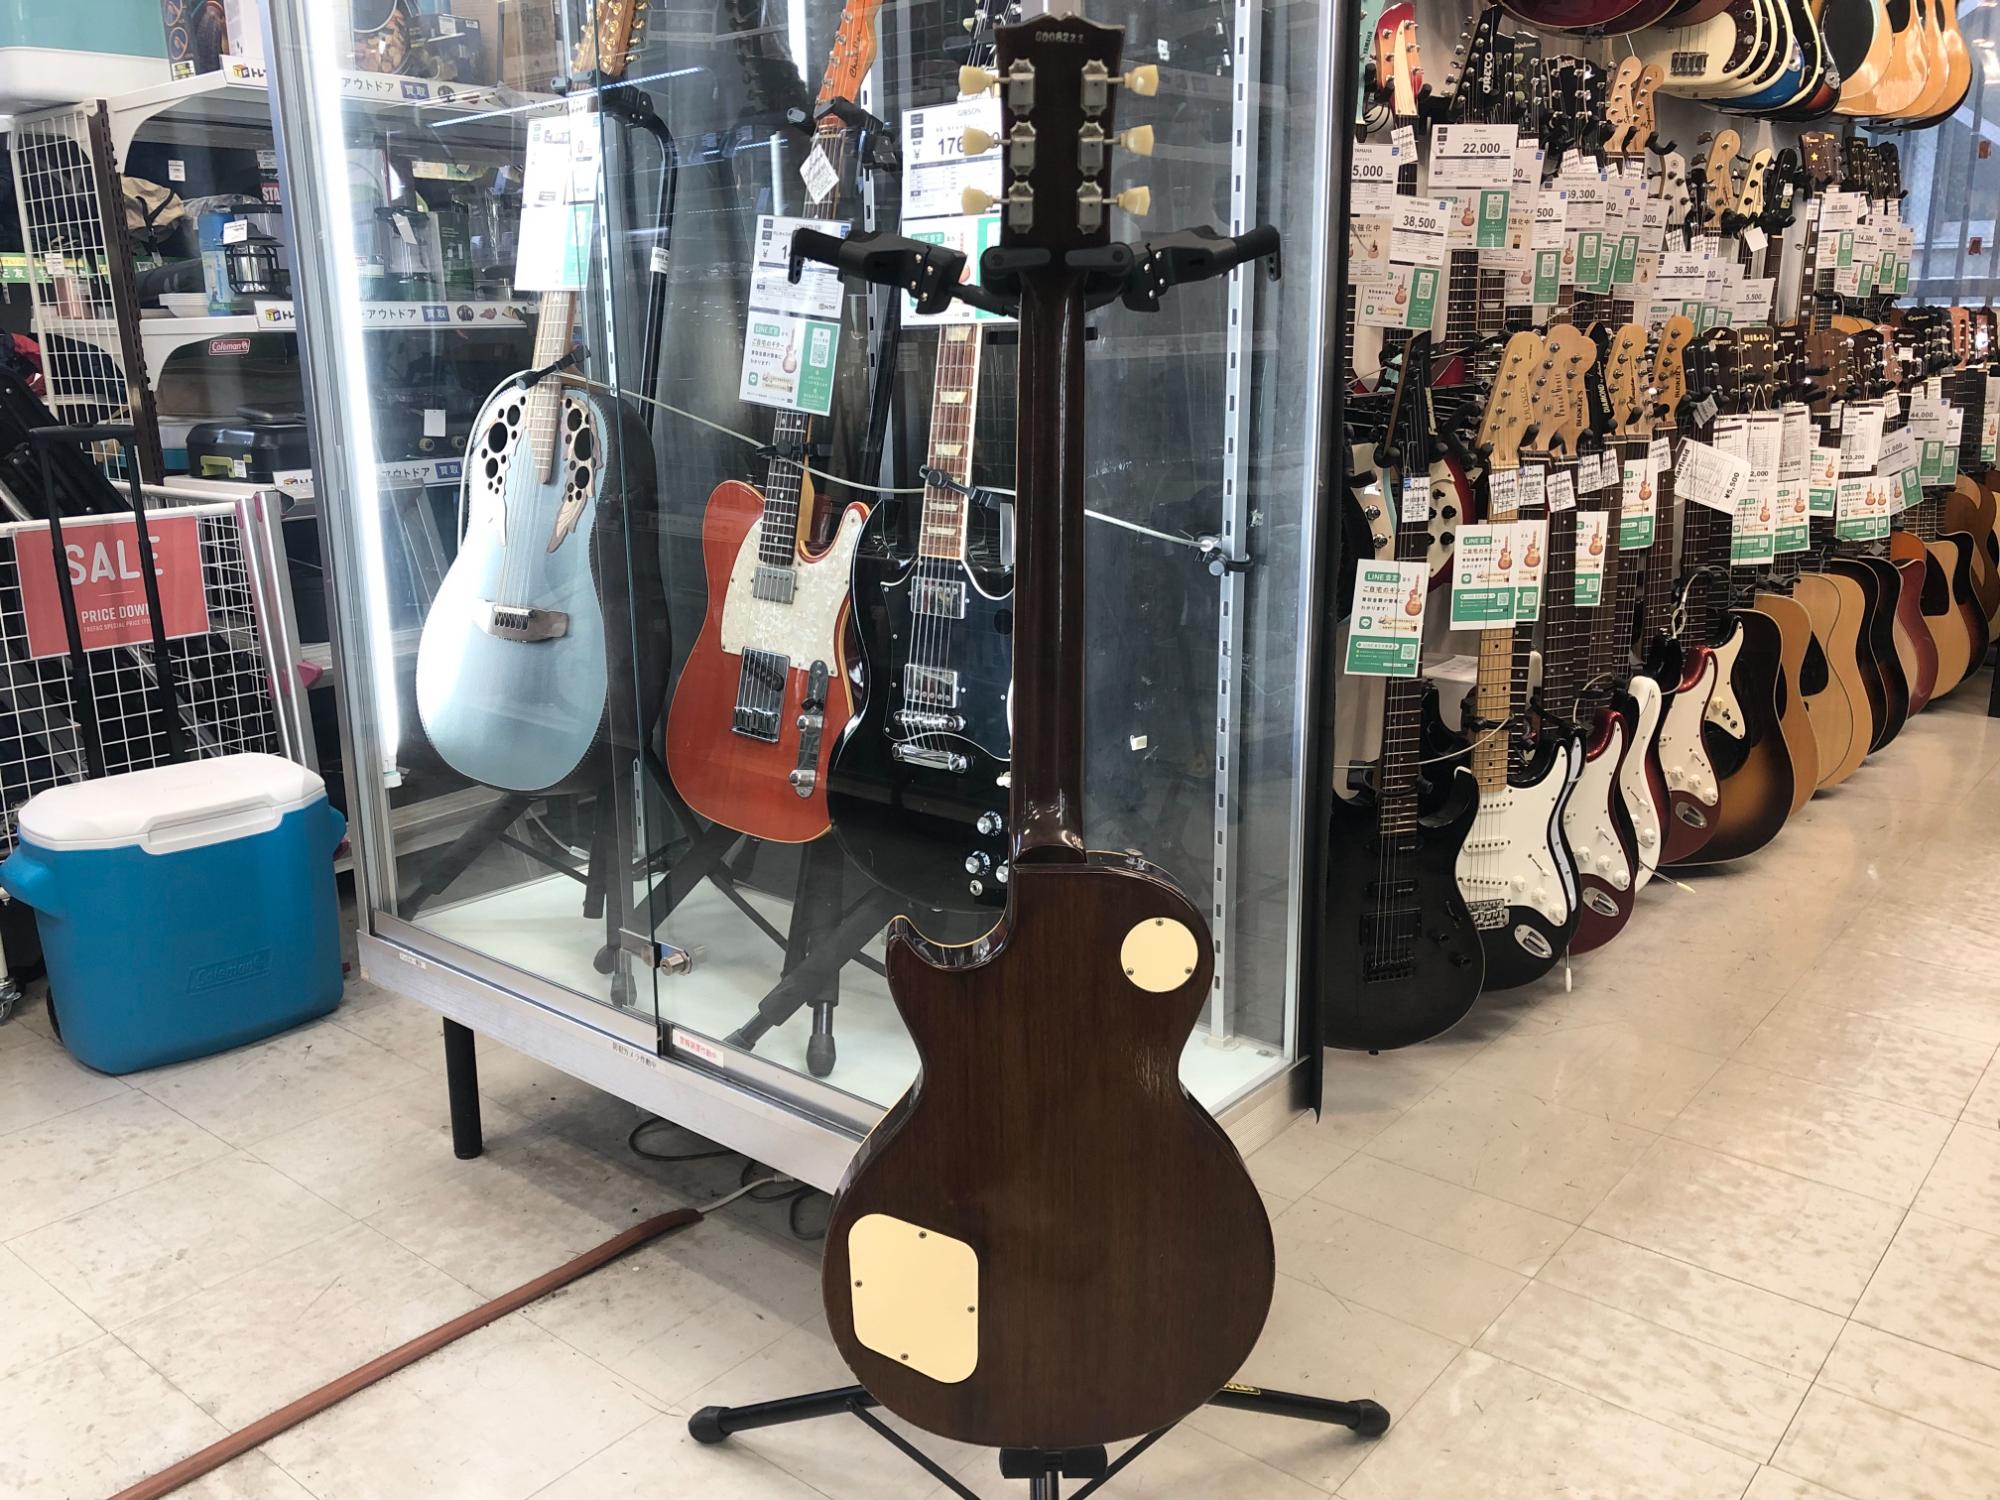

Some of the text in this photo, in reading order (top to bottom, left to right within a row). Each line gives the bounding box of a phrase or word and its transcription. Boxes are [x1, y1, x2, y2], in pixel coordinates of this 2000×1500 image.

[342, 77, 394, 93] アウトドア
[1463, 143, 1500, 154] 22,000
[1353, 165, 1383, 177] 5,000
[1537, 208, 1553, 217] 500
[1403, 215, 1436, 229] 38,500
[1674, 266, 1699, 274] 36,300
[367, 307, 446, 320] アウトドア 買取
[212, 342, 242, 352] Coleman
[1598, 384, 1611, 414] DIAMOND
[1723, 472, 1740, 499] ¥5,500
[66, 536, 163, 586] SALE
[1363, 585, 1406, 593] ご自宅のギター
[80, 606, 116, 624] PRICE
[104, 621, 125, 631] SPECIAL
[126, 618, 141, 627] PRICE
